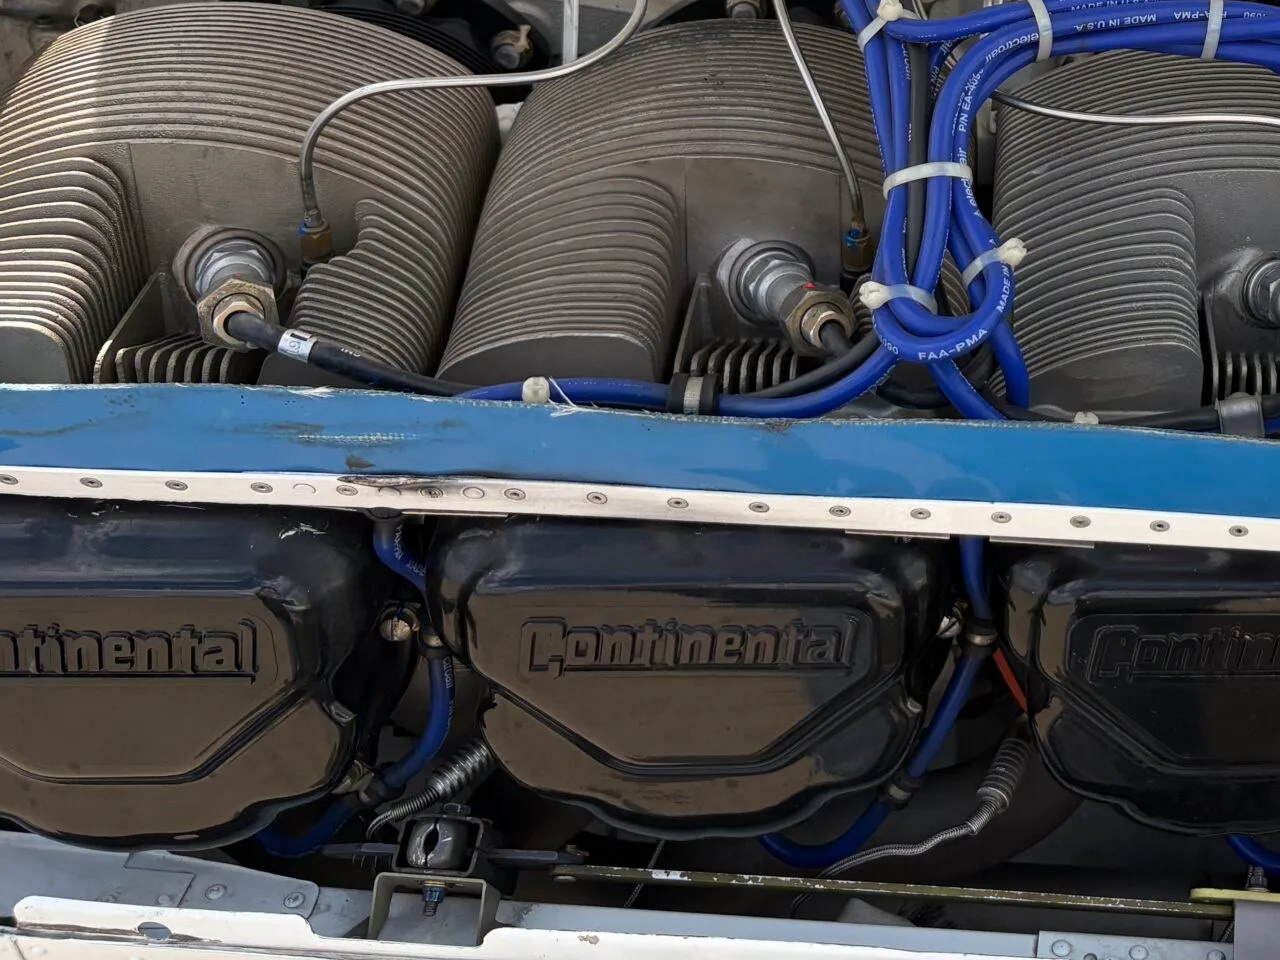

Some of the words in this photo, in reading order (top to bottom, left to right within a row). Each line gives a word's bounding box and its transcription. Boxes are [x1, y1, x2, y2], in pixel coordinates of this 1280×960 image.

[1073, 20, 1106, 32] U.S.A.
[1109, 18, 1121, 27] IN
[1123, 14, 1157, 24] MADE
[985, 31, 1040, 64] electroair
[958, 112, 969, 133] P/N
[1002, 264, 1010, 278] IN
[995, 277, 1012, 313] MADE
[918, 328, 988, 360] FAA-PMA
[521, 616, 860, 679] Continental
